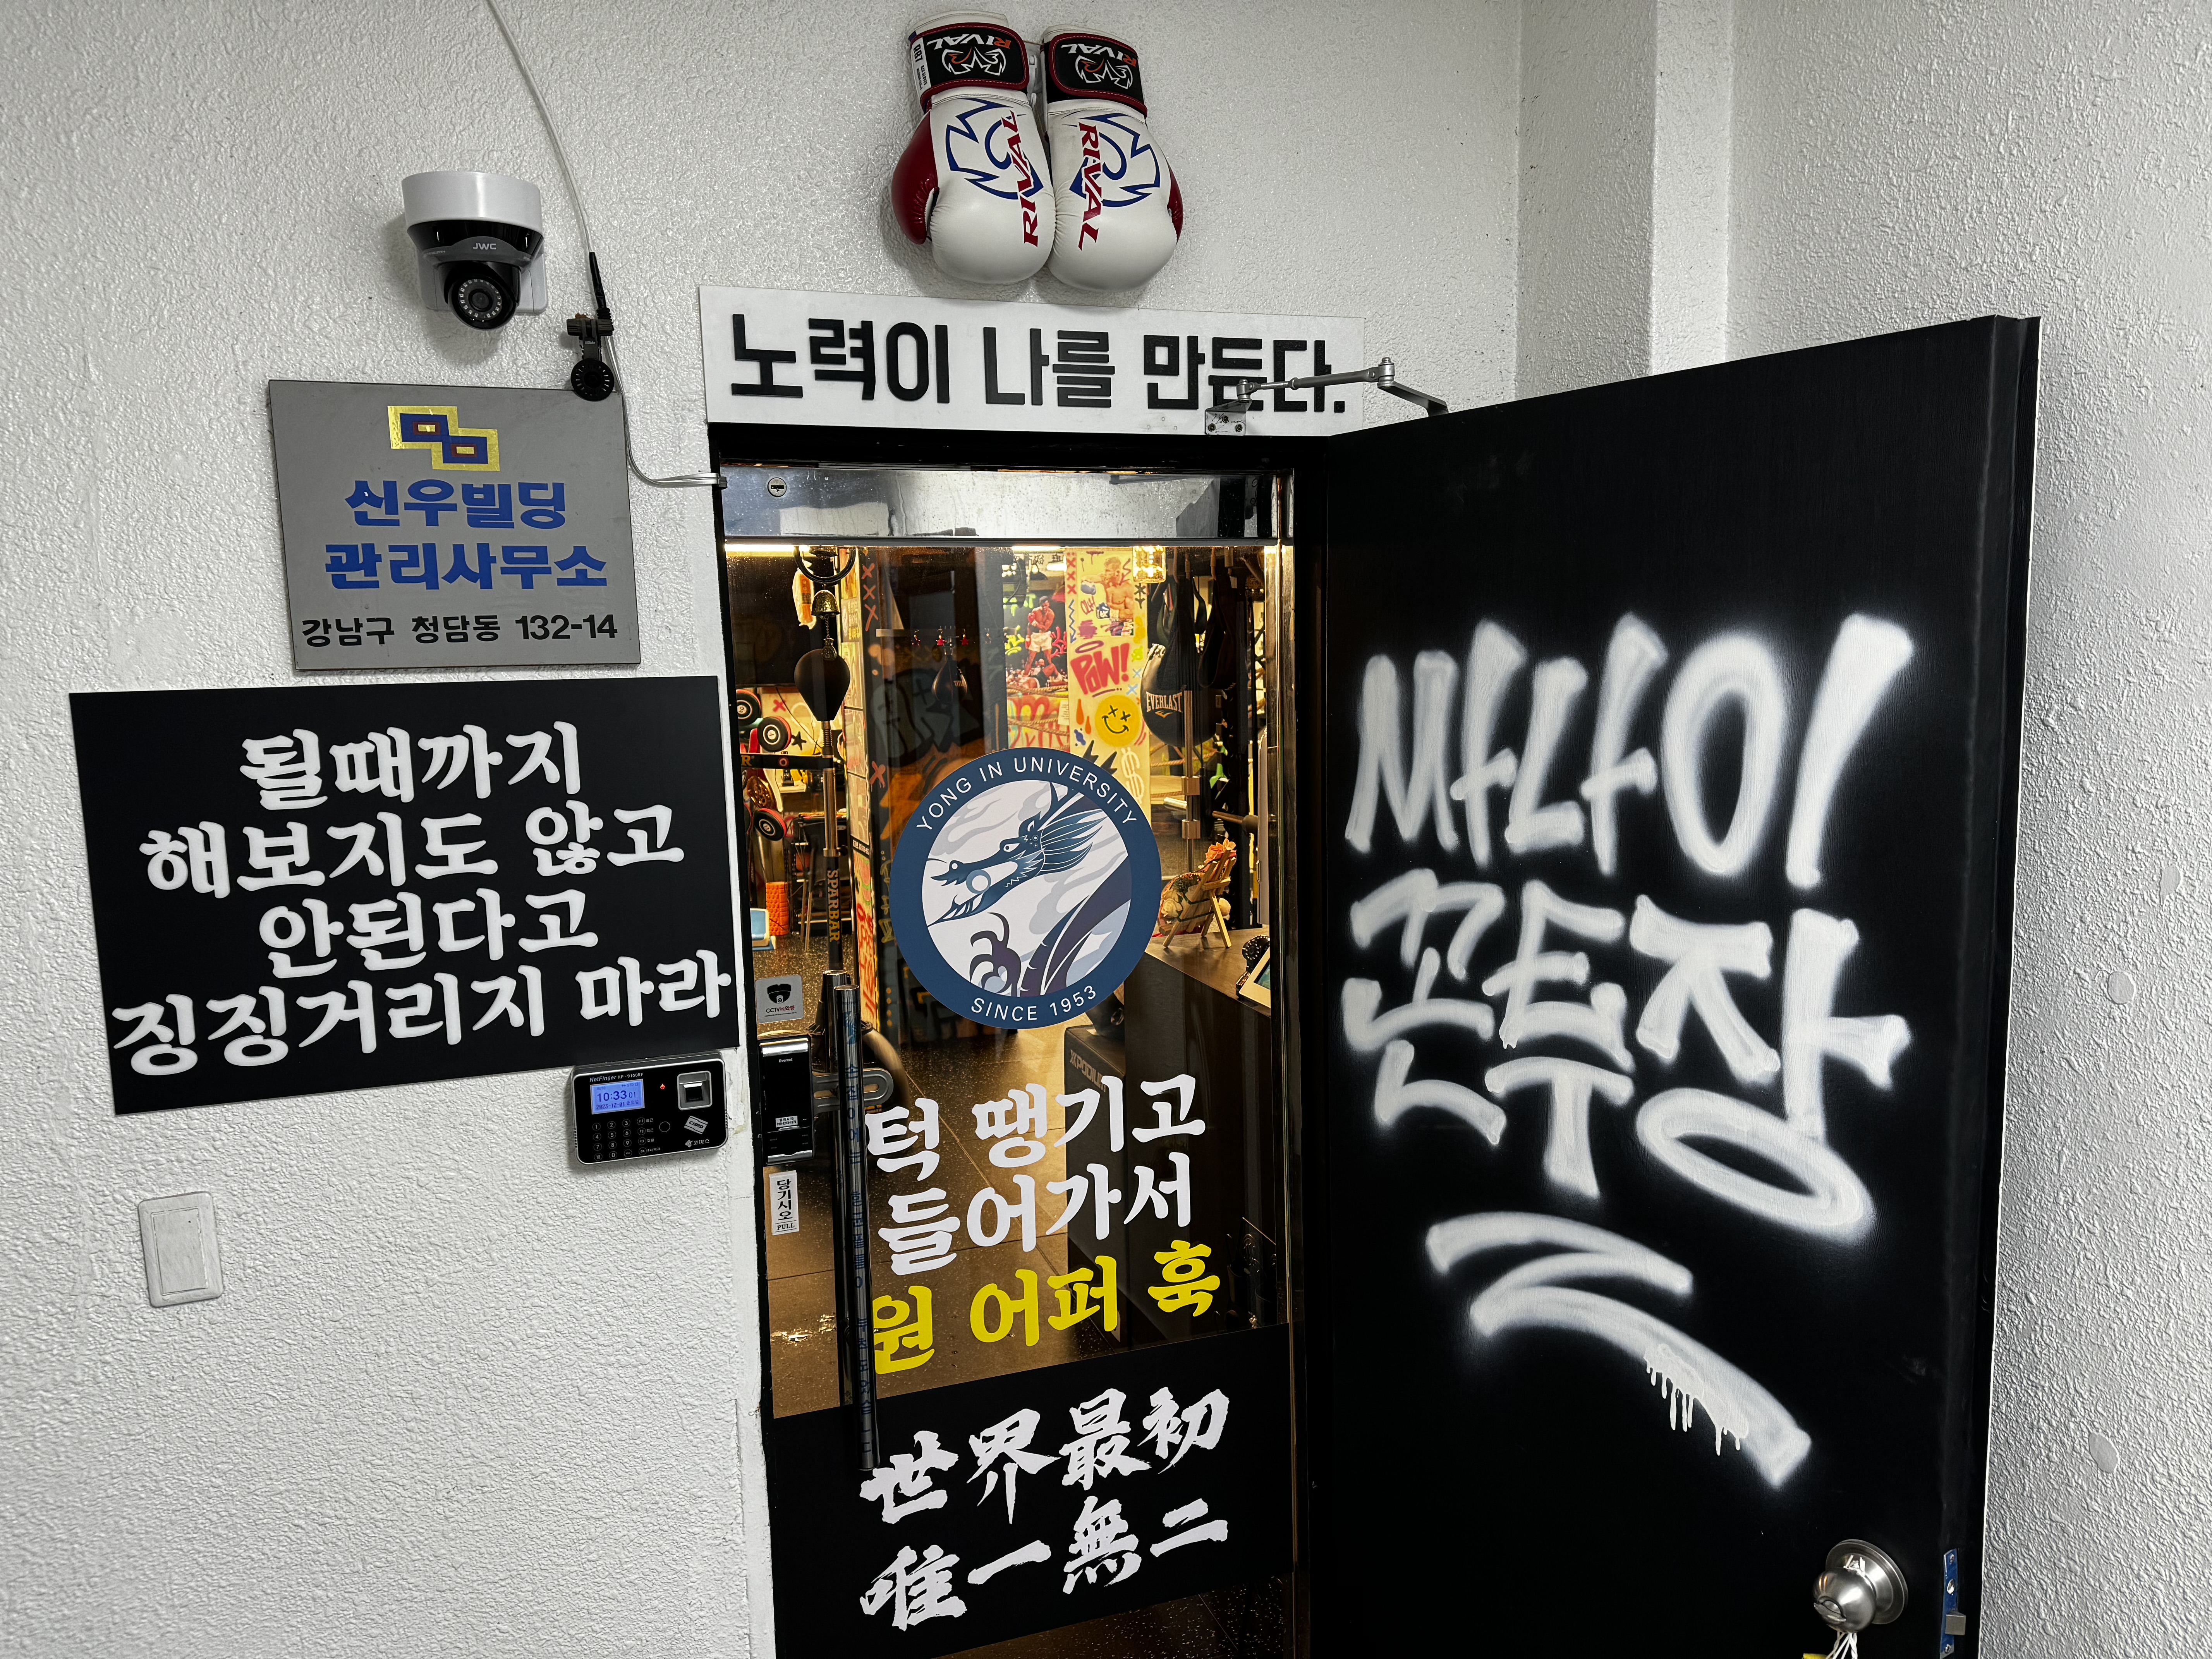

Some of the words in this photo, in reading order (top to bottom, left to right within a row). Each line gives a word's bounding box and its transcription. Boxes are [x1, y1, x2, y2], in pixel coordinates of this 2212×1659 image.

[913, 43, 923, 63] RB7
[926, 34, 1012, 50] RIVAL
[1061, 43, 1137, 67] RIVAL
[1001, 110, 1038, 247] RIVAL
[1078, 122, 1102, 251] RIVAL
[732, 314, 950, 403] 노력이
[983, 327, 1115, 408] 나를
[1144, 335, 1345, 413] 만든다.
[347, 479, 565, 529] 신우빌딩
[326, 543, 607, 589] 관리사무소
[302, 618, 394, 647] 강남구
[412, 615, 500, 643] 청담동
[515, 614, 618, 640] 132-14
[1146, 691, 1183, 713] EVERLAST
[240, 721, 580, 810] 될때까지
[916, 778, 972, 830] YONG
[979, 761, 1003, 782] IN
[1014, 757, 1137, 824] UNIVERSITY
[139, 812, 498, 898] 해보지도
[526, 800, 684, 876] 않고
[259, 888, 598, 979] 안된다고
[827, 870, 840, 942] SPARBAR
[112, 965, 544, 1076] 징징거리지
[575, 950, 731, 1026] 마라
[971, 998, 1037, 1022] SINCE
[1050, 985, 1096, 1017] 1953
[597, 1090, 627, 1102] 10:33
[865, 1098, 939, 1181] 턱
[972, 1074, 1205, 1168] 땡기고
[777, 1179, 793, 1220] 당기시오
[877, 1152, 1190, 1275] 들어가서
[872, 1286, 934, 1374] 원
[970, 1256, 1117, 1346] 어퍼
[1148, 1240, 1220, 1317] 훅
[860, 1386, 1230, 1525] 世界最初
[860, 1496, 1228, 1631] 唯一無二
